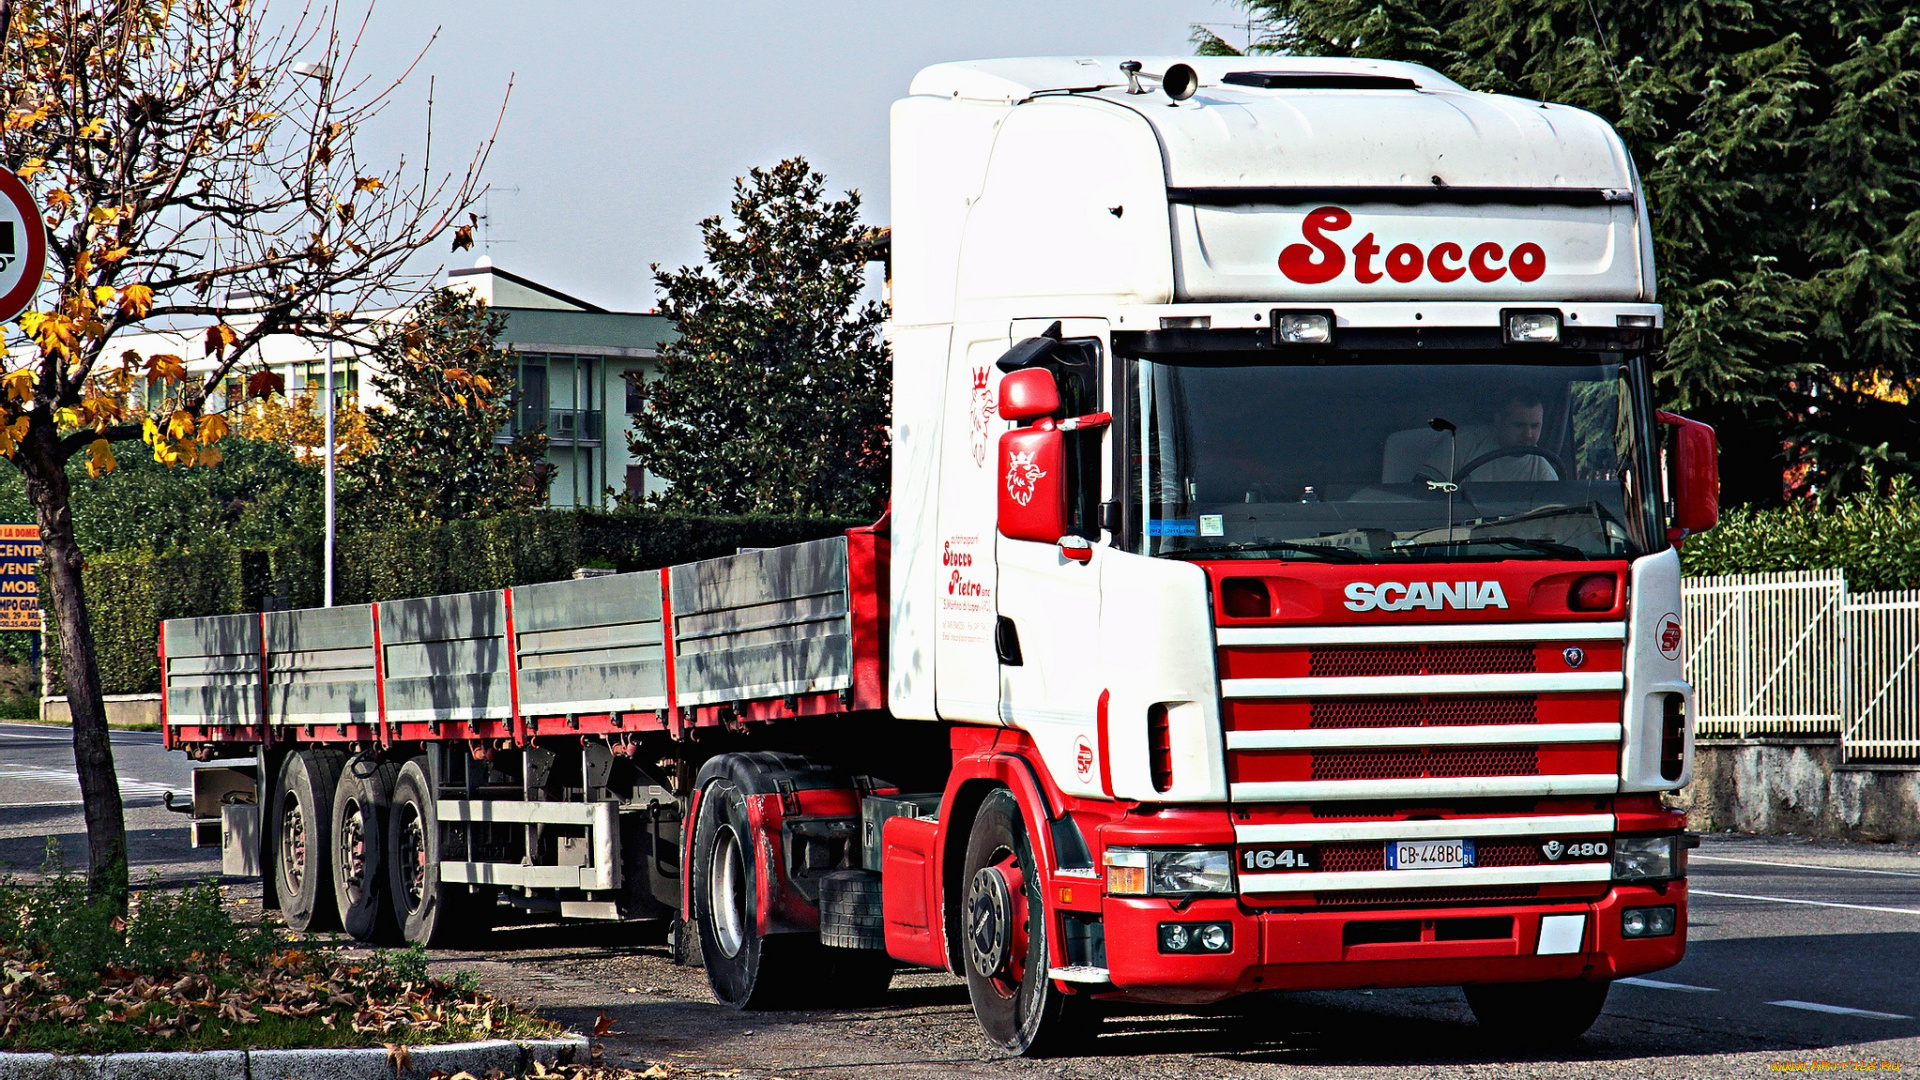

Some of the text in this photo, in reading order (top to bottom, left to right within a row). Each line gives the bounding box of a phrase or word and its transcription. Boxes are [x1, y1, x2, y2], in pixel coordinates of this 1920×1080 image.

[1278, 206, 1546, 284] Stocco
[4, 528, 13, 537] LA
[943, 540, 972, 566] Stocco
[949, 569, 981, 597] Pietro
[1343, 580, 1509, 612] SCANIA
[1463, 854, 1474, 865] BL
[1567, 842, 1609, 857] 480
